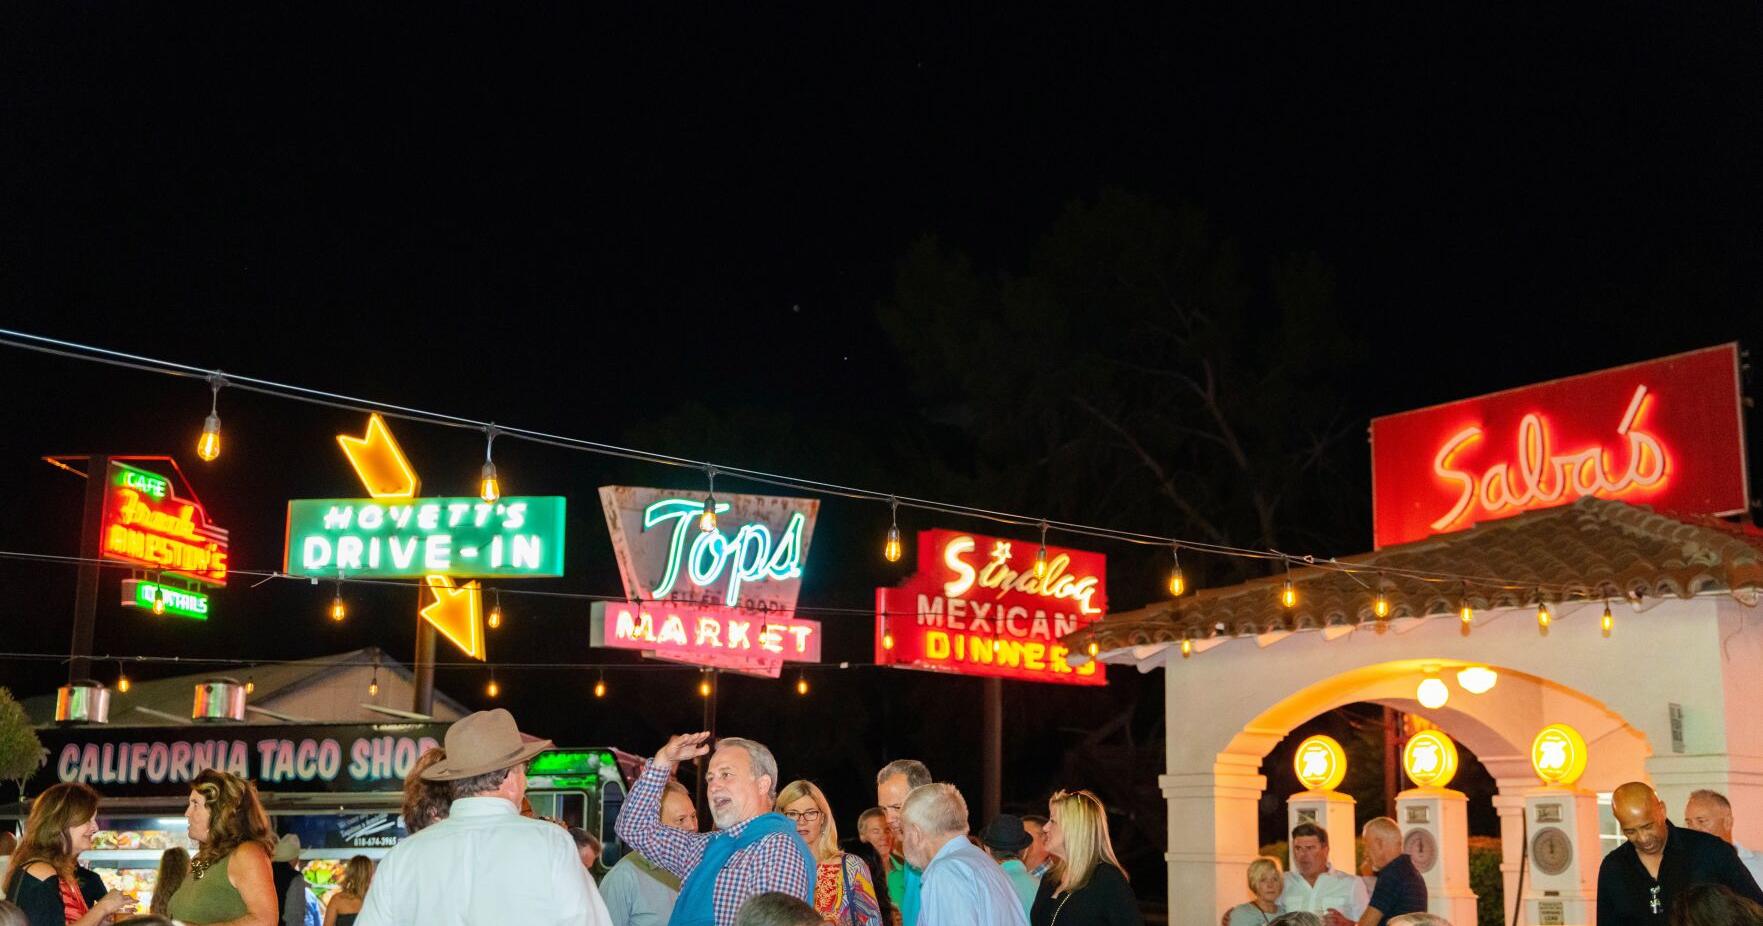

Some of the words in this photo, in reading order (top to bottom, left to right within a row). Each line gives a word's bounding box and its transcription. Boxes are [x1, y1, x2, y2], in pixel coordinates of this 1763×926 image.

[126, 471, 167, 498] CAFE
[303, 534, 541, 570] DRIVE-IN
[644, 498, 805, 607] Tops
[944, 535, 1102, 615] Sinaloa
[141, 584, 208, 614] COKTAILS
[917, 593, 1078, 641] MEXICAN
[614, 610, 813, 653] MARKET
[57, 739, 250, 785] CALIFORNIA
[257, 737, 341, 782] TACO
[1302, 749, 1329, 777] 76
[1411, 745, 1439, 773] 76
[1539, 741, 1567, 769] 76
